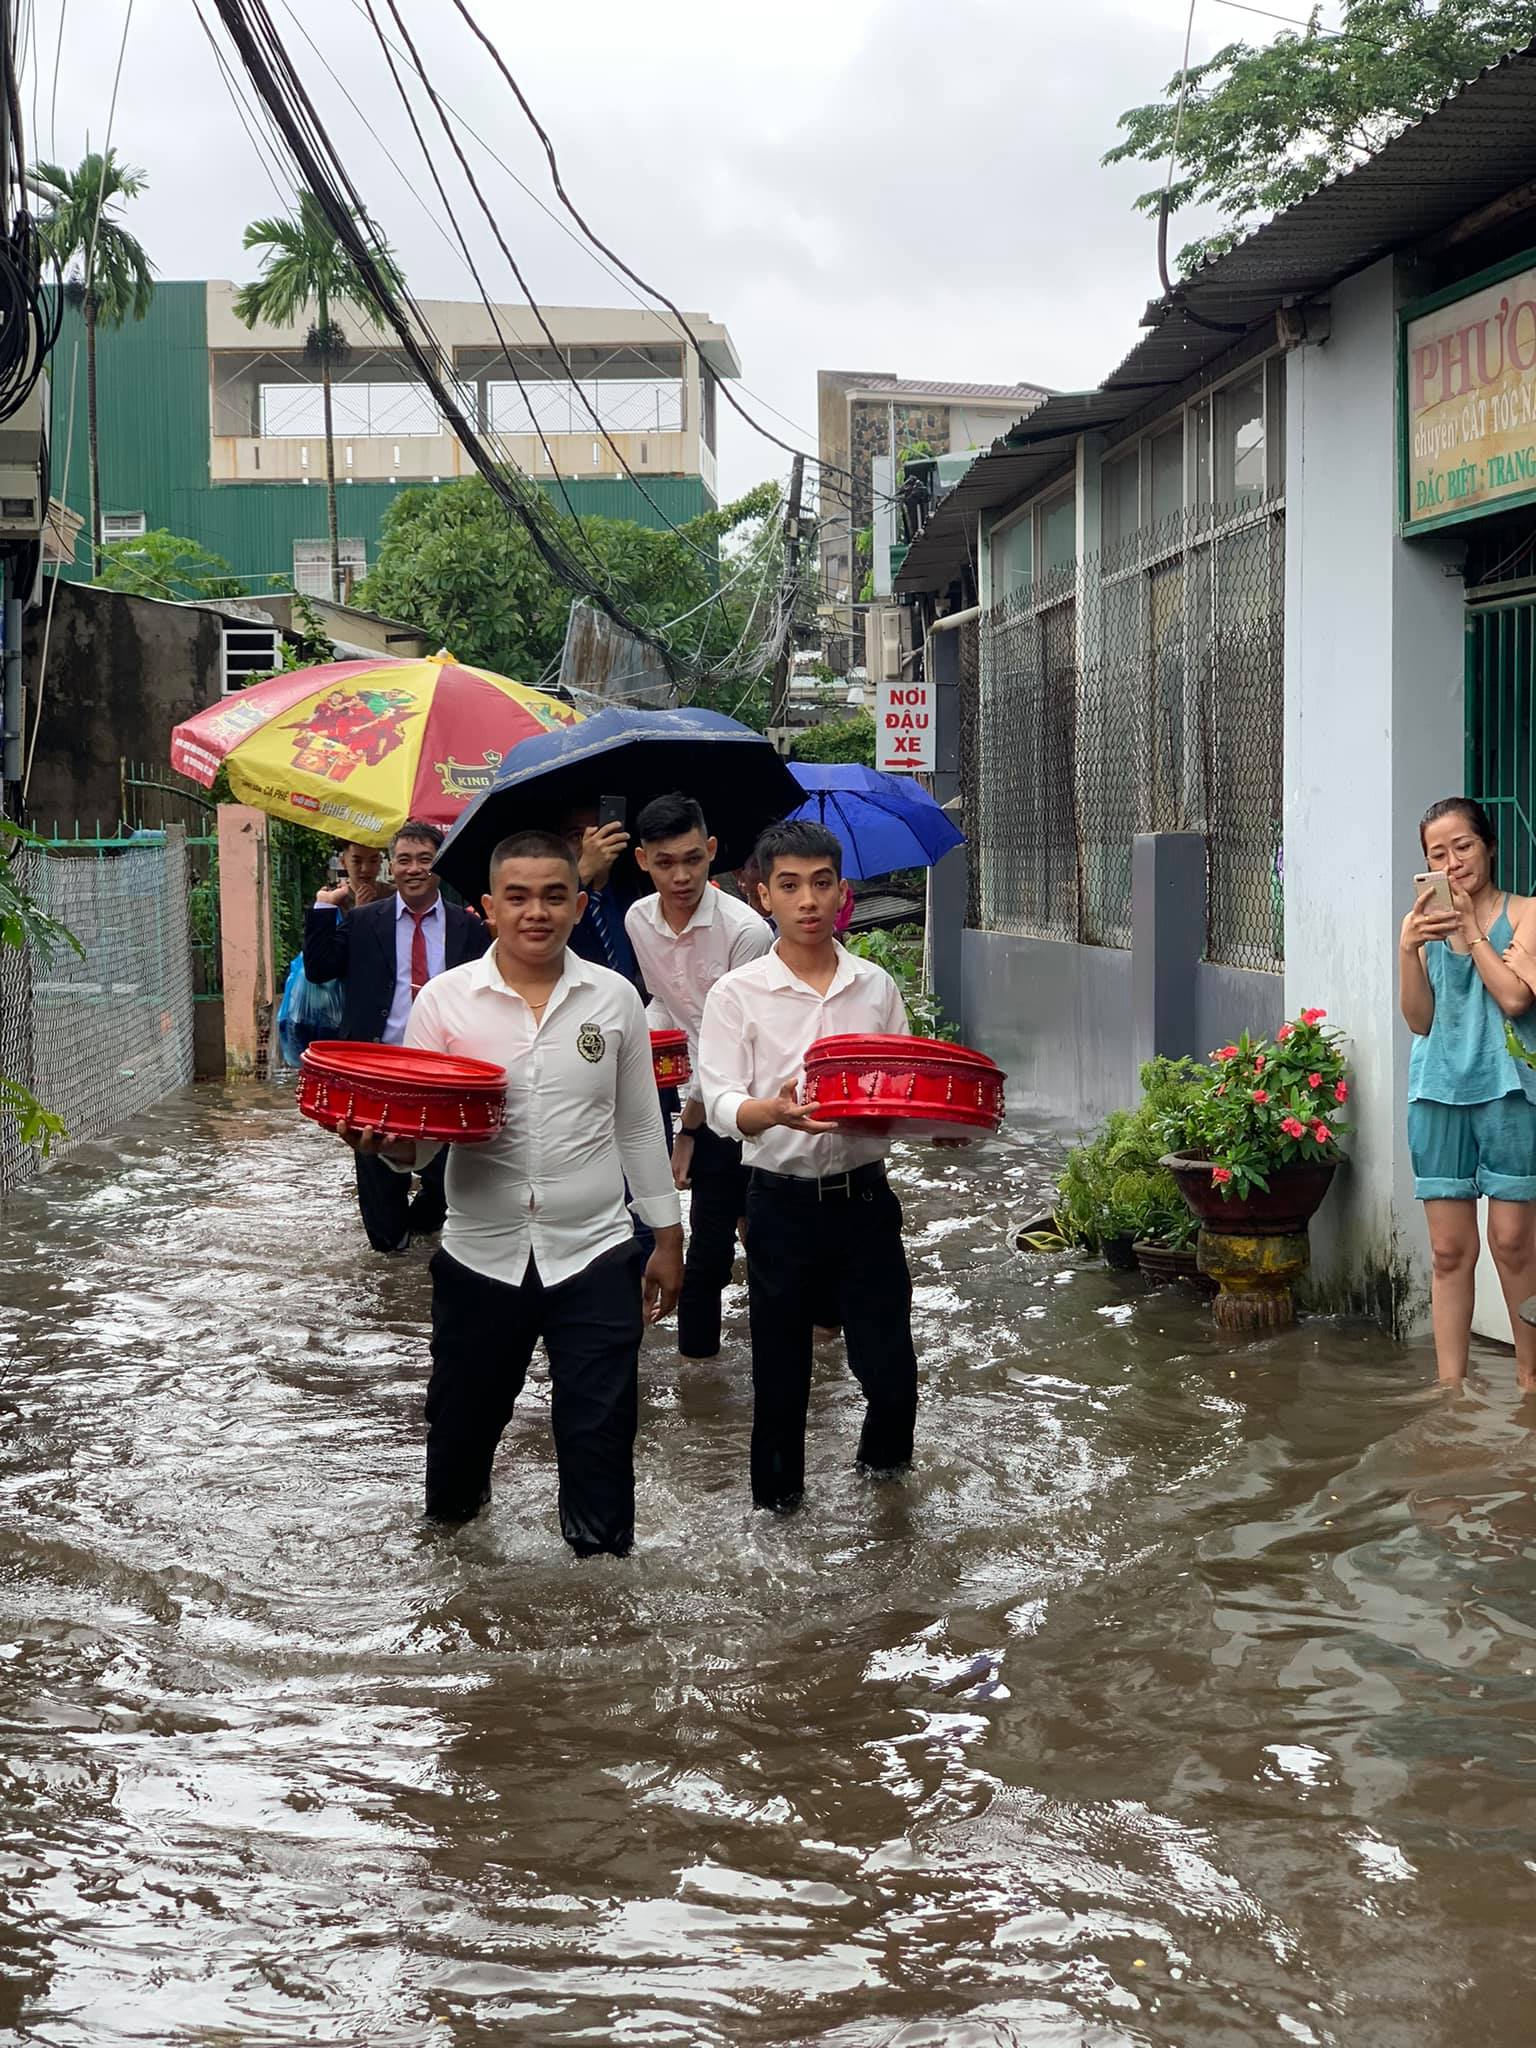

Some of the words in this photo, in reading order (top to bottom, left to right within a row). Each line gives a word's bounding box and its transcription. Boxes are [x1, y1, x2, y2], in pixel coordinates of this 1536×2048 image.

[1490, 381, 1520, 434] TÓC
[889, 686, 927, 706] NƠI
[885, 708, 929, 735] ĐẬU
[894, 736, 921, 753] XE
[457, 776, 490, 786] KING
